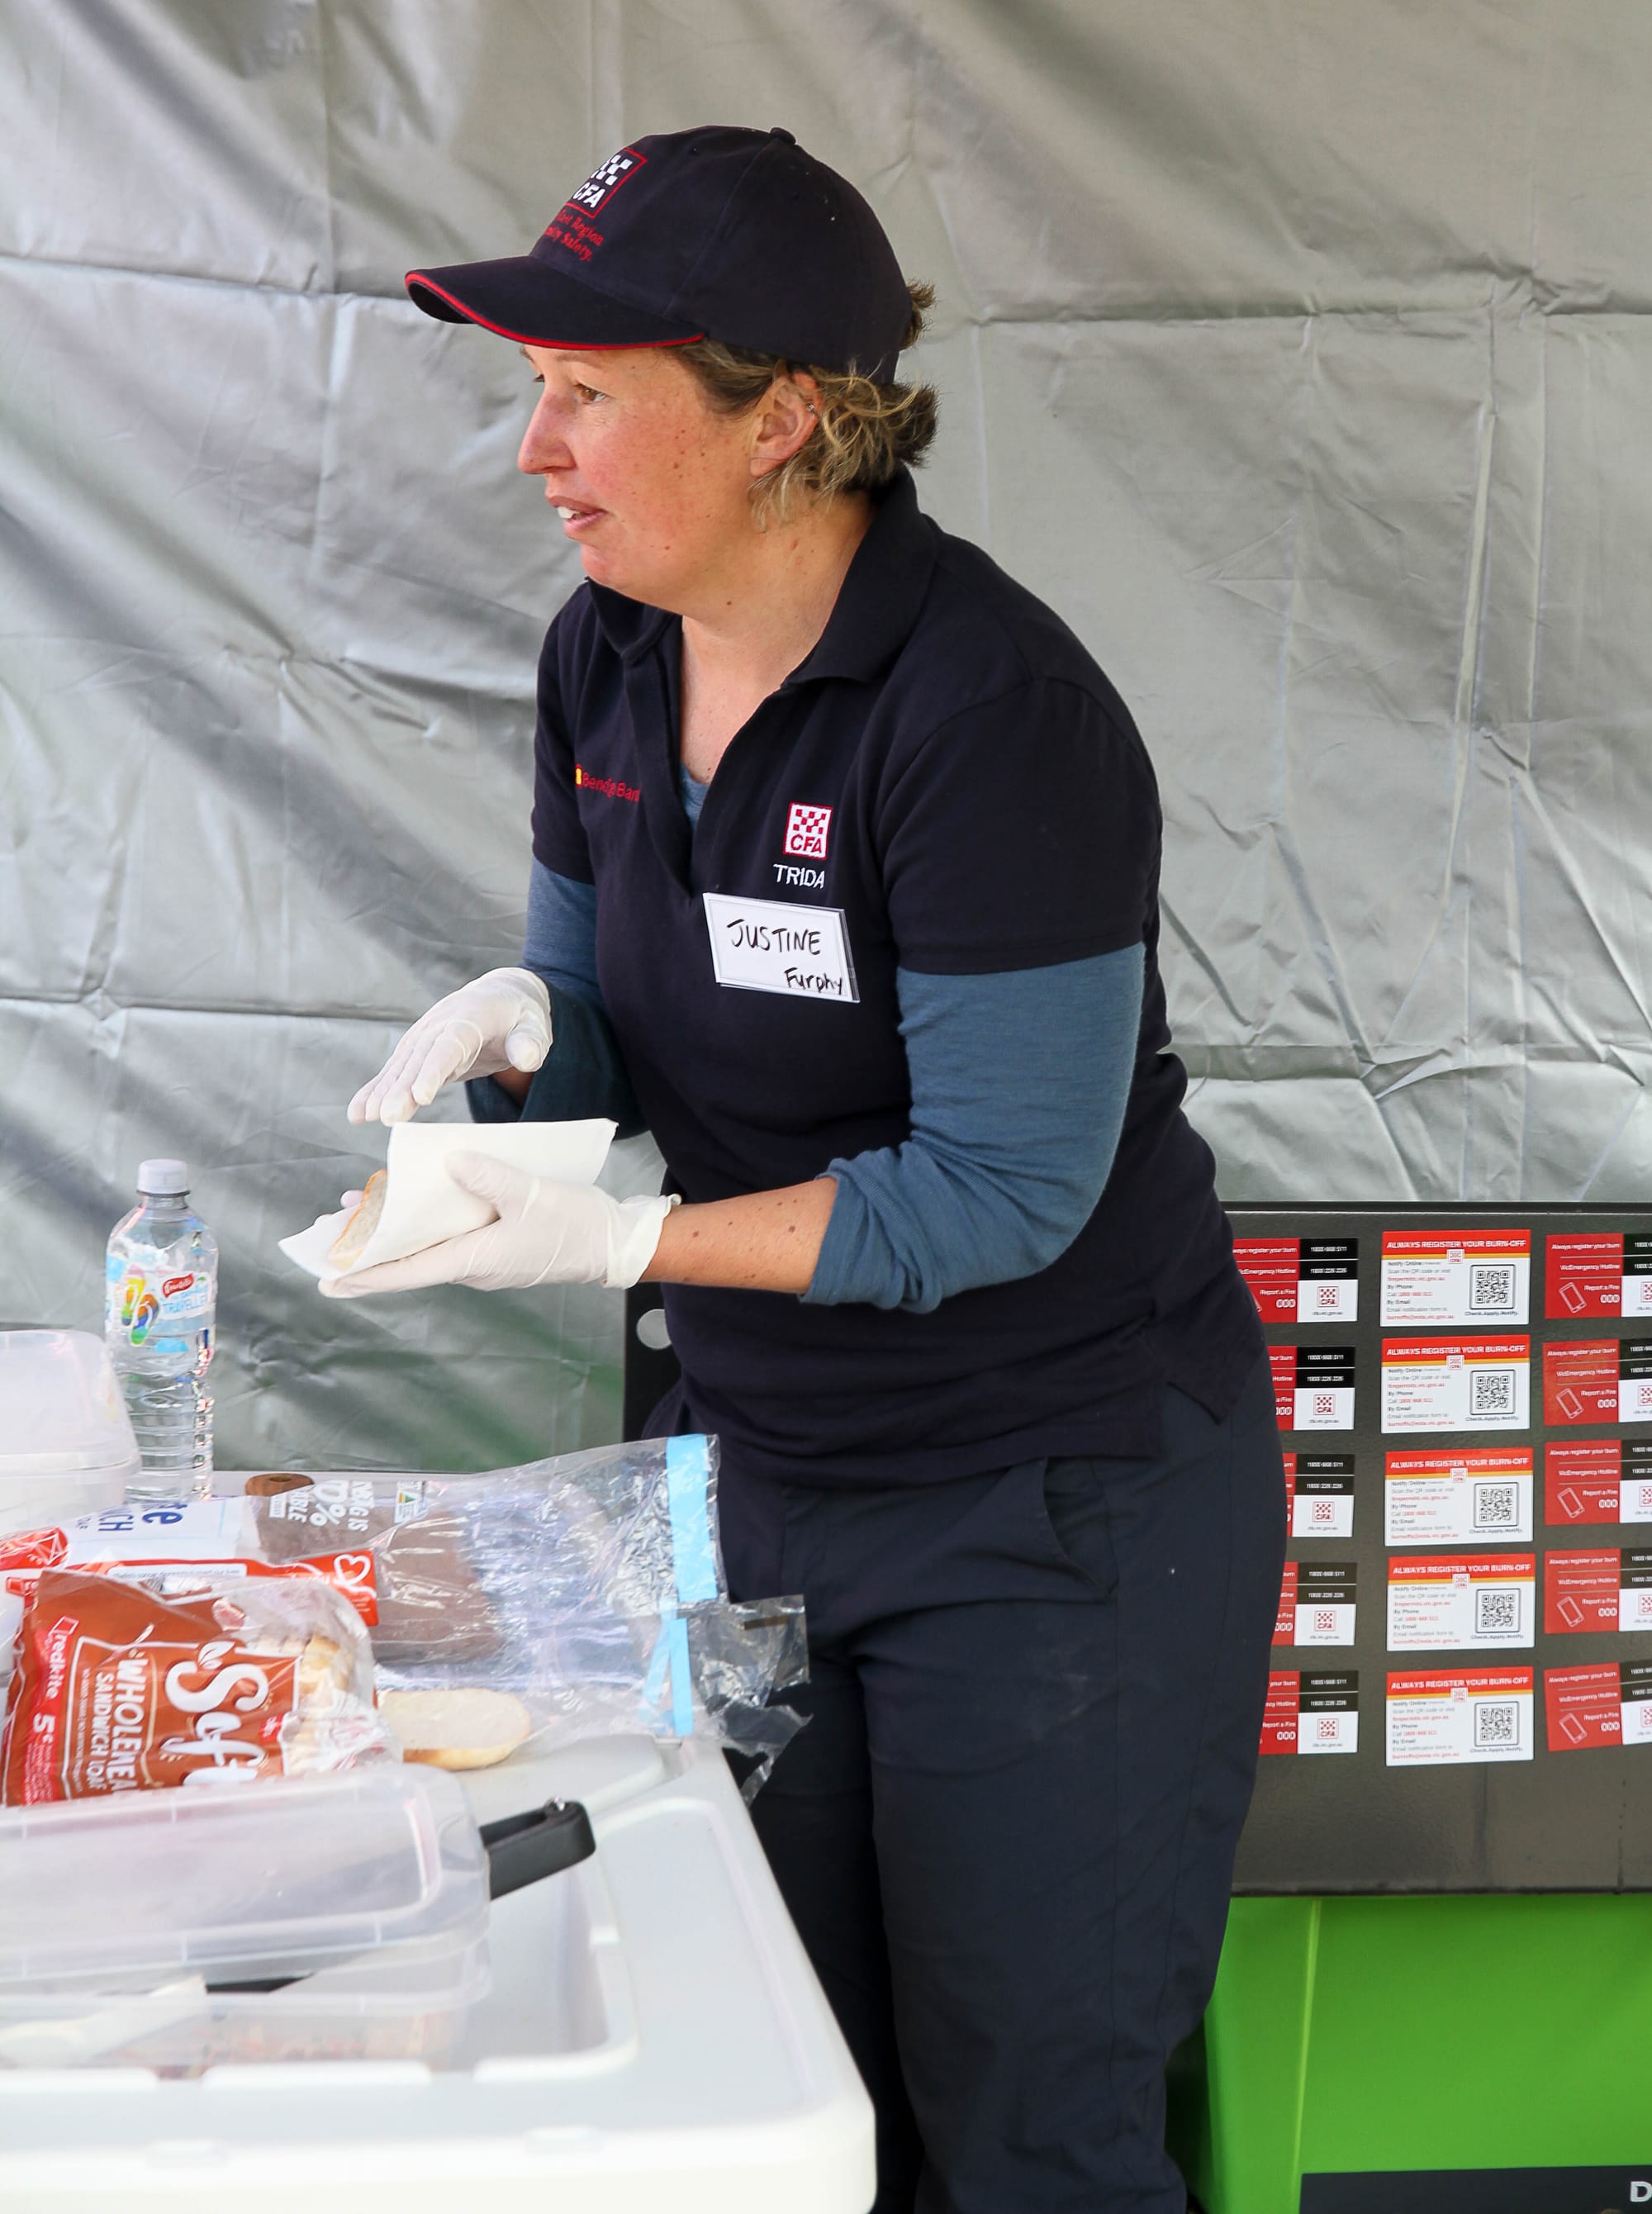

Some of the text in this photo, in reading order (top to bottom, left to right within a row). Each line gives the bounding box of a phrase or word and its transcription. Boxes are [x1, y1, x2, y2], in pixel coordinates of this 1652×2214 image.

[572, 182, 605, 208] CFA
[790, 834, 823, 854] CFA
[773, 863, 825, 889] TRIDA
[726, 919, 821, 956] JUSTINE
[784, 967, 845, 996] Furphy
[1276, 1299, 1295, 1308] 000
[1490, 1677, 1530, 1685] BURN-OFF
[91, 1671, 116, 1757] SANDWICH
[1277, 1732, 1296, 1740] 000
